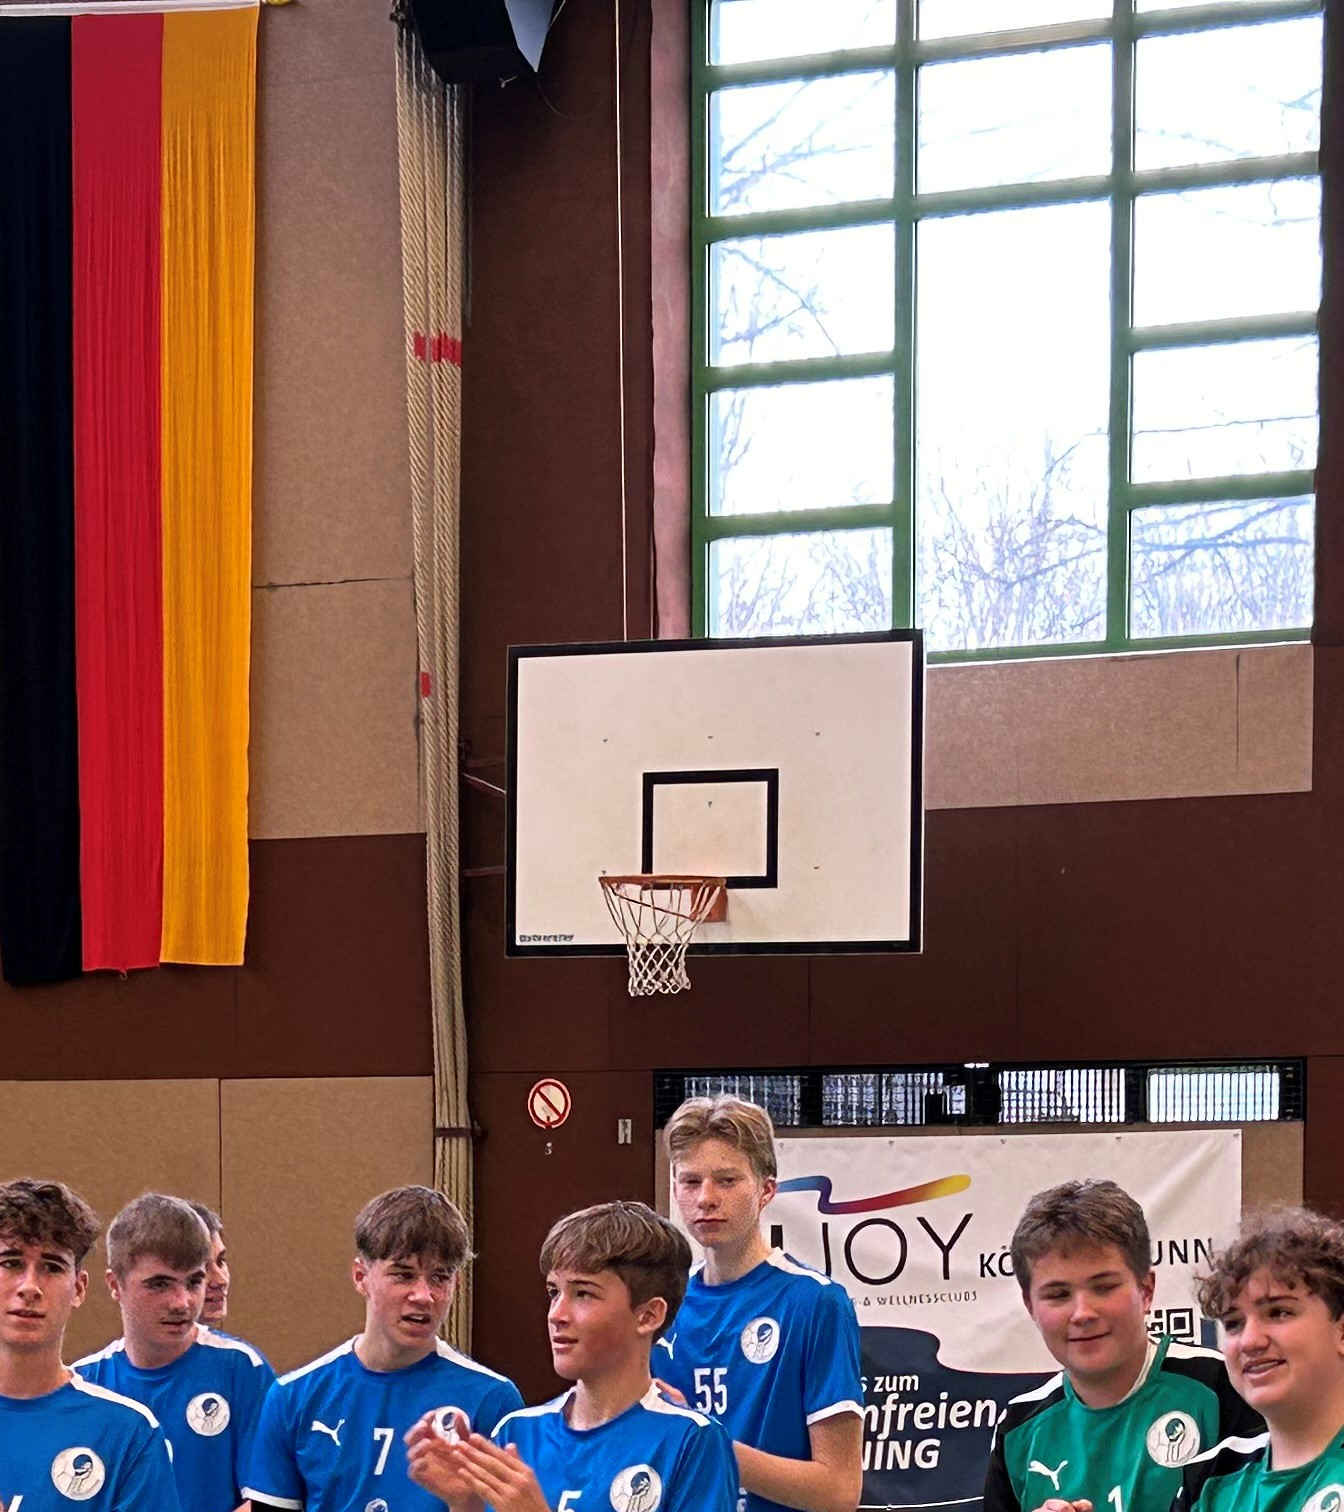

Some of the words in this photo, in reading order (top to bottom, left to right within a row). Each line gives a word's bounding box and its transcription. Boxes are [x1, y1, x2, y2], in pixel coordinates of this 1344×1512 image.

[693, 1367, 729, 1416] 55
[873, 1374, 920, 1393] zum
[372, 1427, 395, 1476] 7
